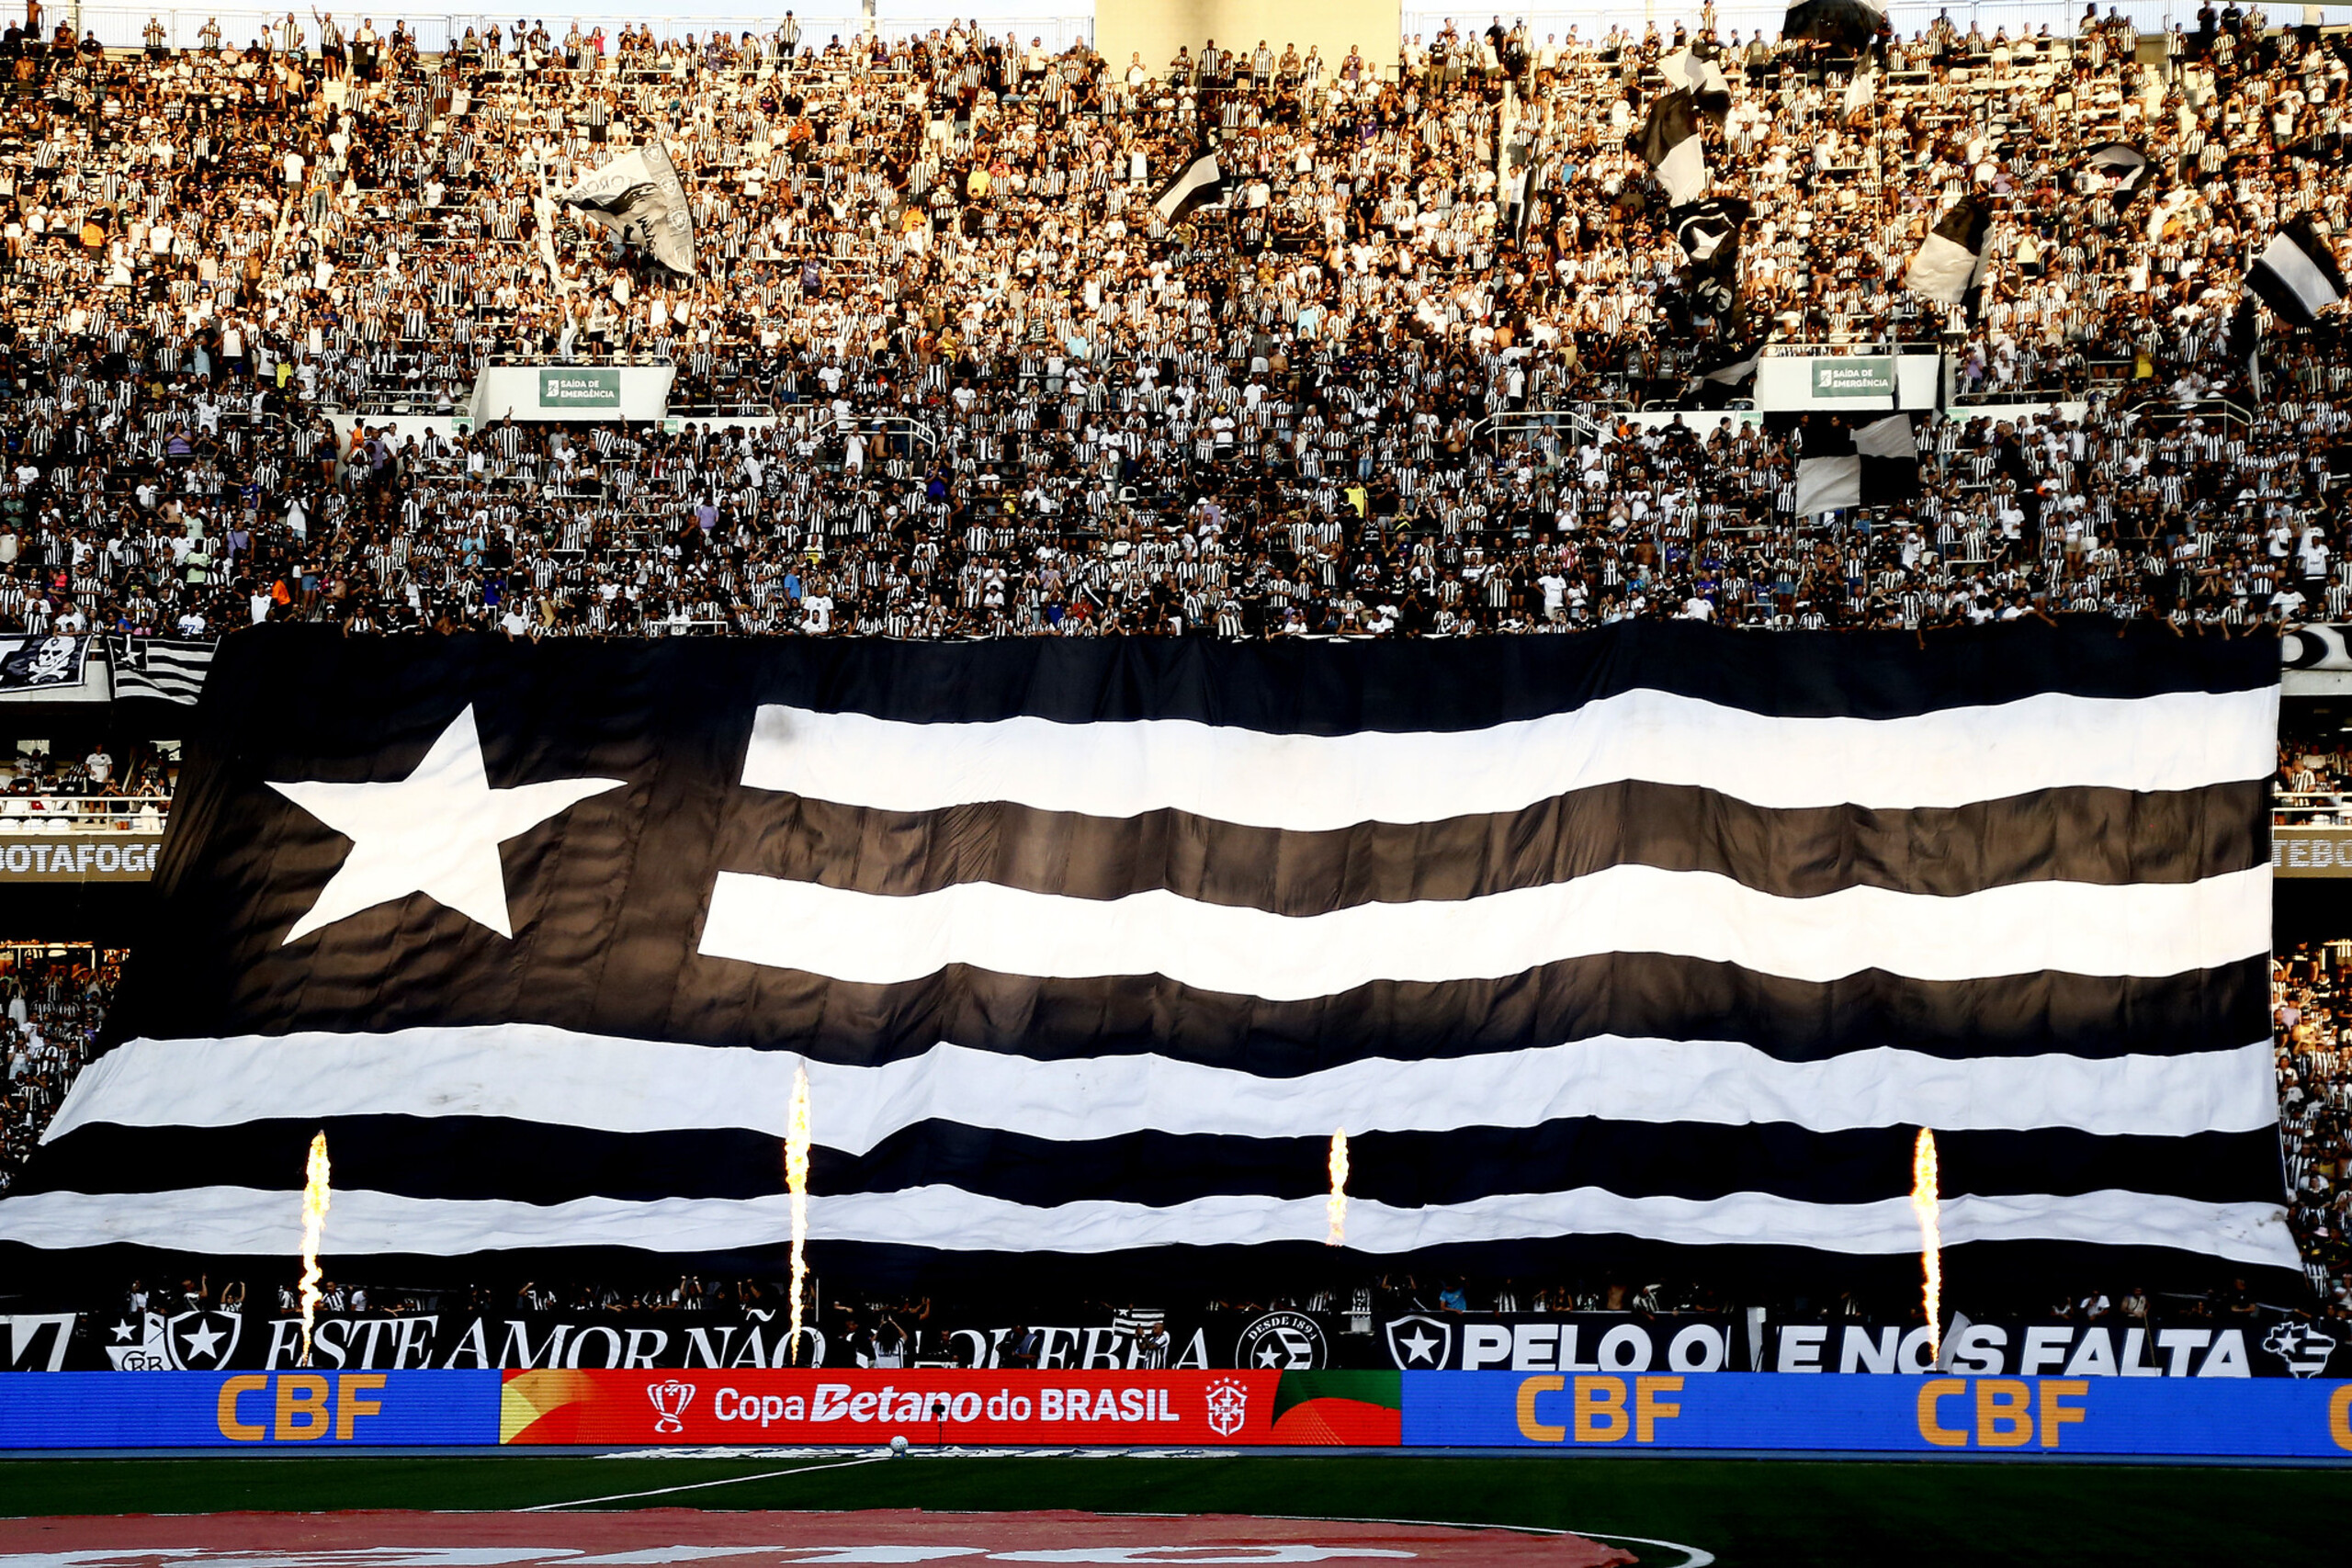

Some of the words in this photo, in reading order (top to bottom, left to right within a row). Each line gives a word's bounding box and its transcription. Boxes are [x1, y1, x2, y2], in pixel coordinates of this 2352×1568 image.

[560, 378, 586, 388] SAÍDA
[588, 379, 600, 388] DE
[560, 389, 616, 399] EMERGÊNCIA
[1833, 368, 1860, 378] SAÍDA
[1861, 369, 1873, 378] DE
[1833, 378, 1889, 388] EMERGÊNCIA
[442, 1316, 669, 1371] AMOR
[1248, 1316, 1289, 1340] DESDE
[1462, 1324, 1653, 1372] PELO
[2020, 1325, 2252, 1378] FALTA
[217, 1374, 387, 1441] CBF
[714, 1387, 805, 1428] Copa
[809, 1383, 983, 1424] Betano
[986, 1388, 1032, 1422] do
[1039, 1388, 1181, 1422] BRASIL
[1516, 1375, 1685, 1442] CBF
[1917, 1379, 2090, 1448] CBF
